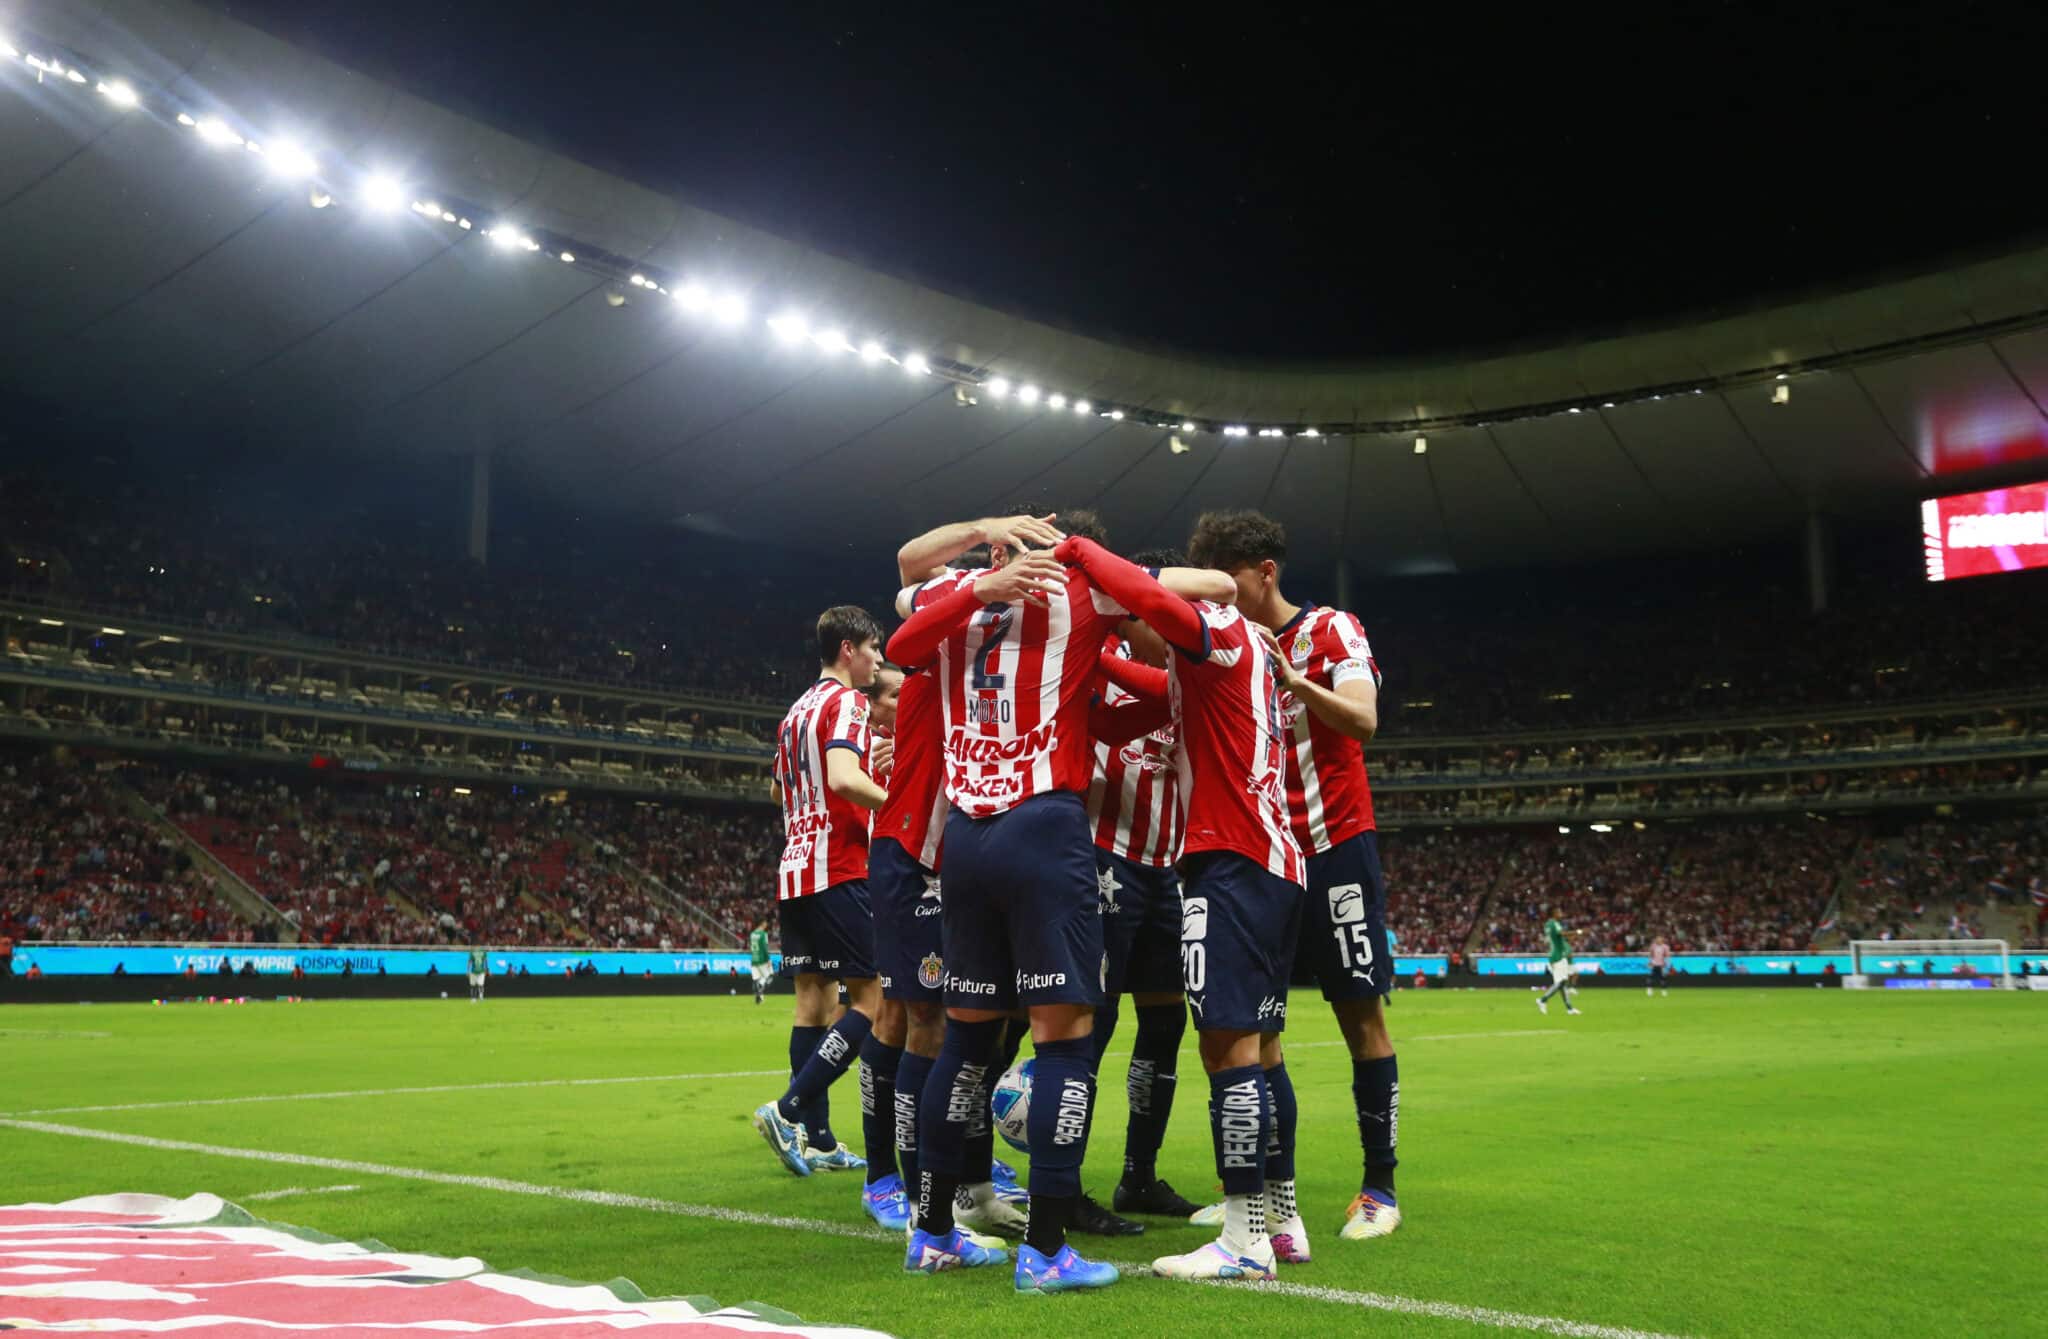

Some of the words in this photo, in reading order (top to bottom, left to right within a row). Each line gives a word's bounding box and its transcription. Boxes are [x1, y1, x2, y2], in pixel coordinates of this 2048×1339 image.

[972, 601, 1014, 690] 2
[969, 699, 1010, 723] MOZO
[946, 722, 1053, 763] AKRON
[173, 955, 185, 969] Y
[1334, 922, 1374, 968] 15
[951, 977, 996, 994] Futura
[1023, 973, 1066, 990] Futura
[895, 1089, 917, 1152] PERDURA
[1053, 1078, 1089, 1145] PERDURA
[1221, 1079, 1260, 1168] PERDURA
